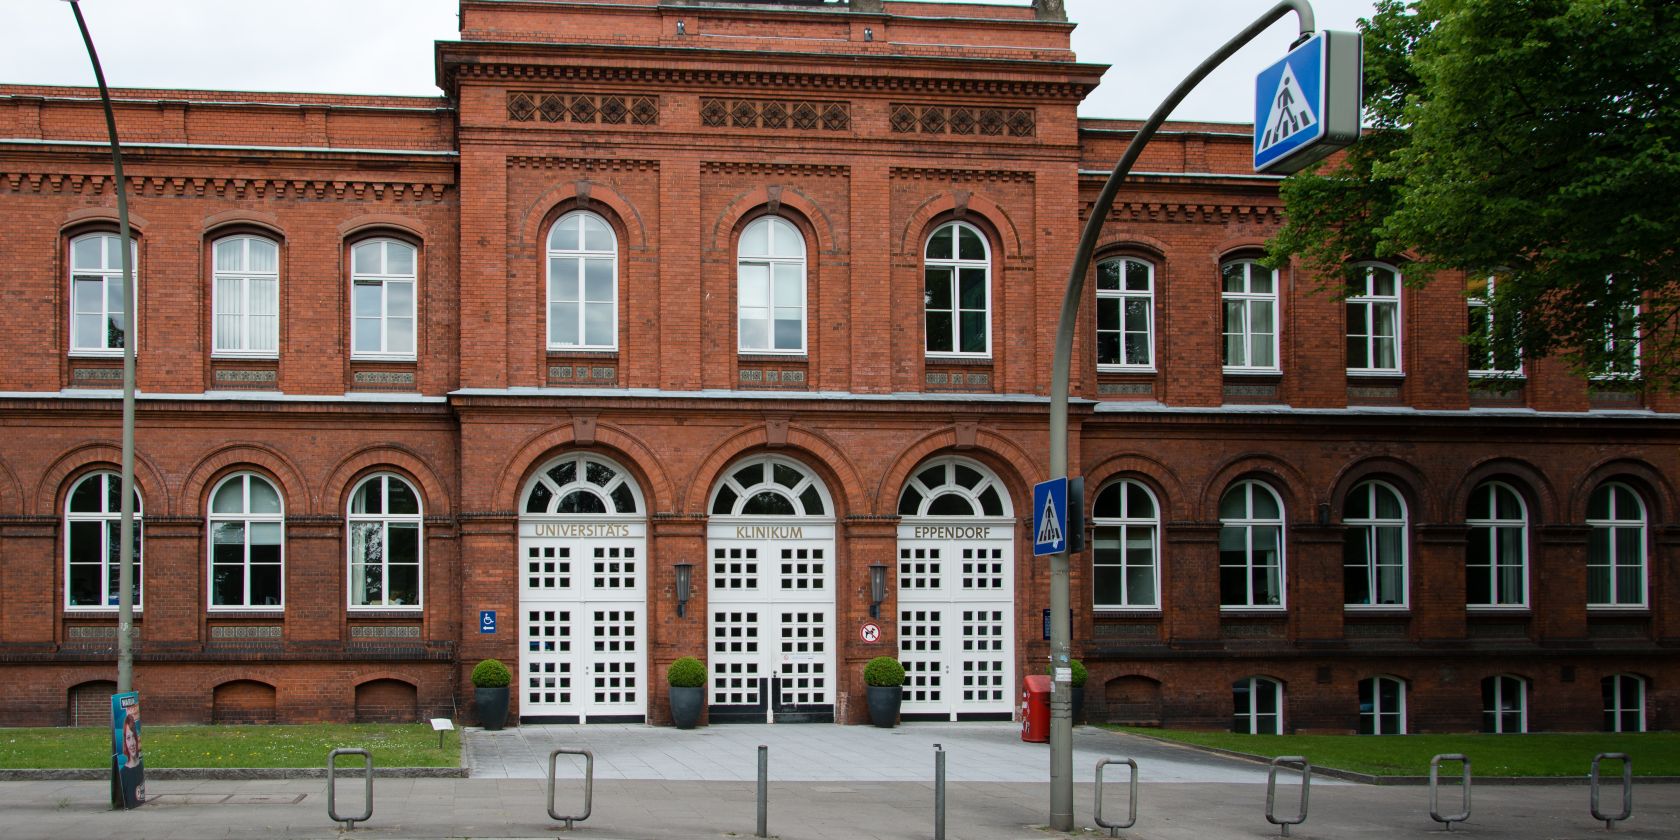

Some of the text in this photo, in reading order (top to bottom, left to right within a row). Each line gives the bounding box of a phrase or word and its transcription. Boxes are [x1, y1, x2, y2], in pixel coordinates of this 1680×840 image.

[535, 523, 629, 537] UNIVERSITÄTS
[736, 526, 803, 539] KLINIKUM
[914, 526, 990, 539] EPPENDORF
